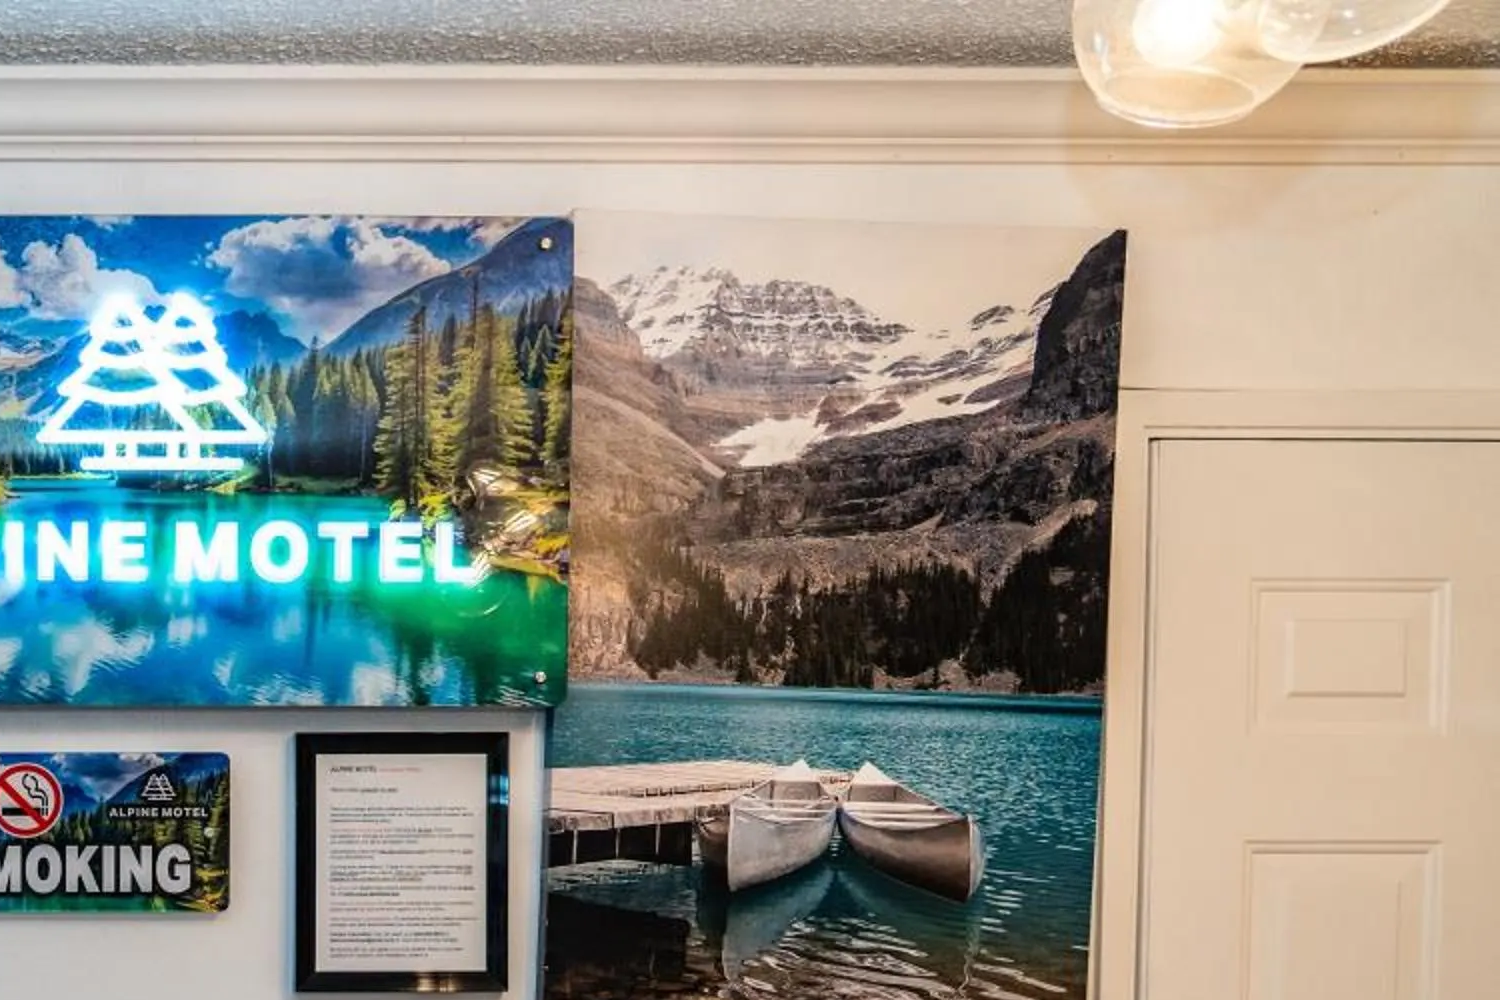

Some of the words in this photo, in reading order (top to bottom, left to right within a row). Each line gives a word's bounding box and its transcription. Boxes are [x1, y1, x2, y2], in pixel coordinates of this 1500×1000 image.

[173, 520, 477, 584] MOTEL
[109, 807, 159, 818] ALPINE
[161, 807, 209, 818] MOTEL
